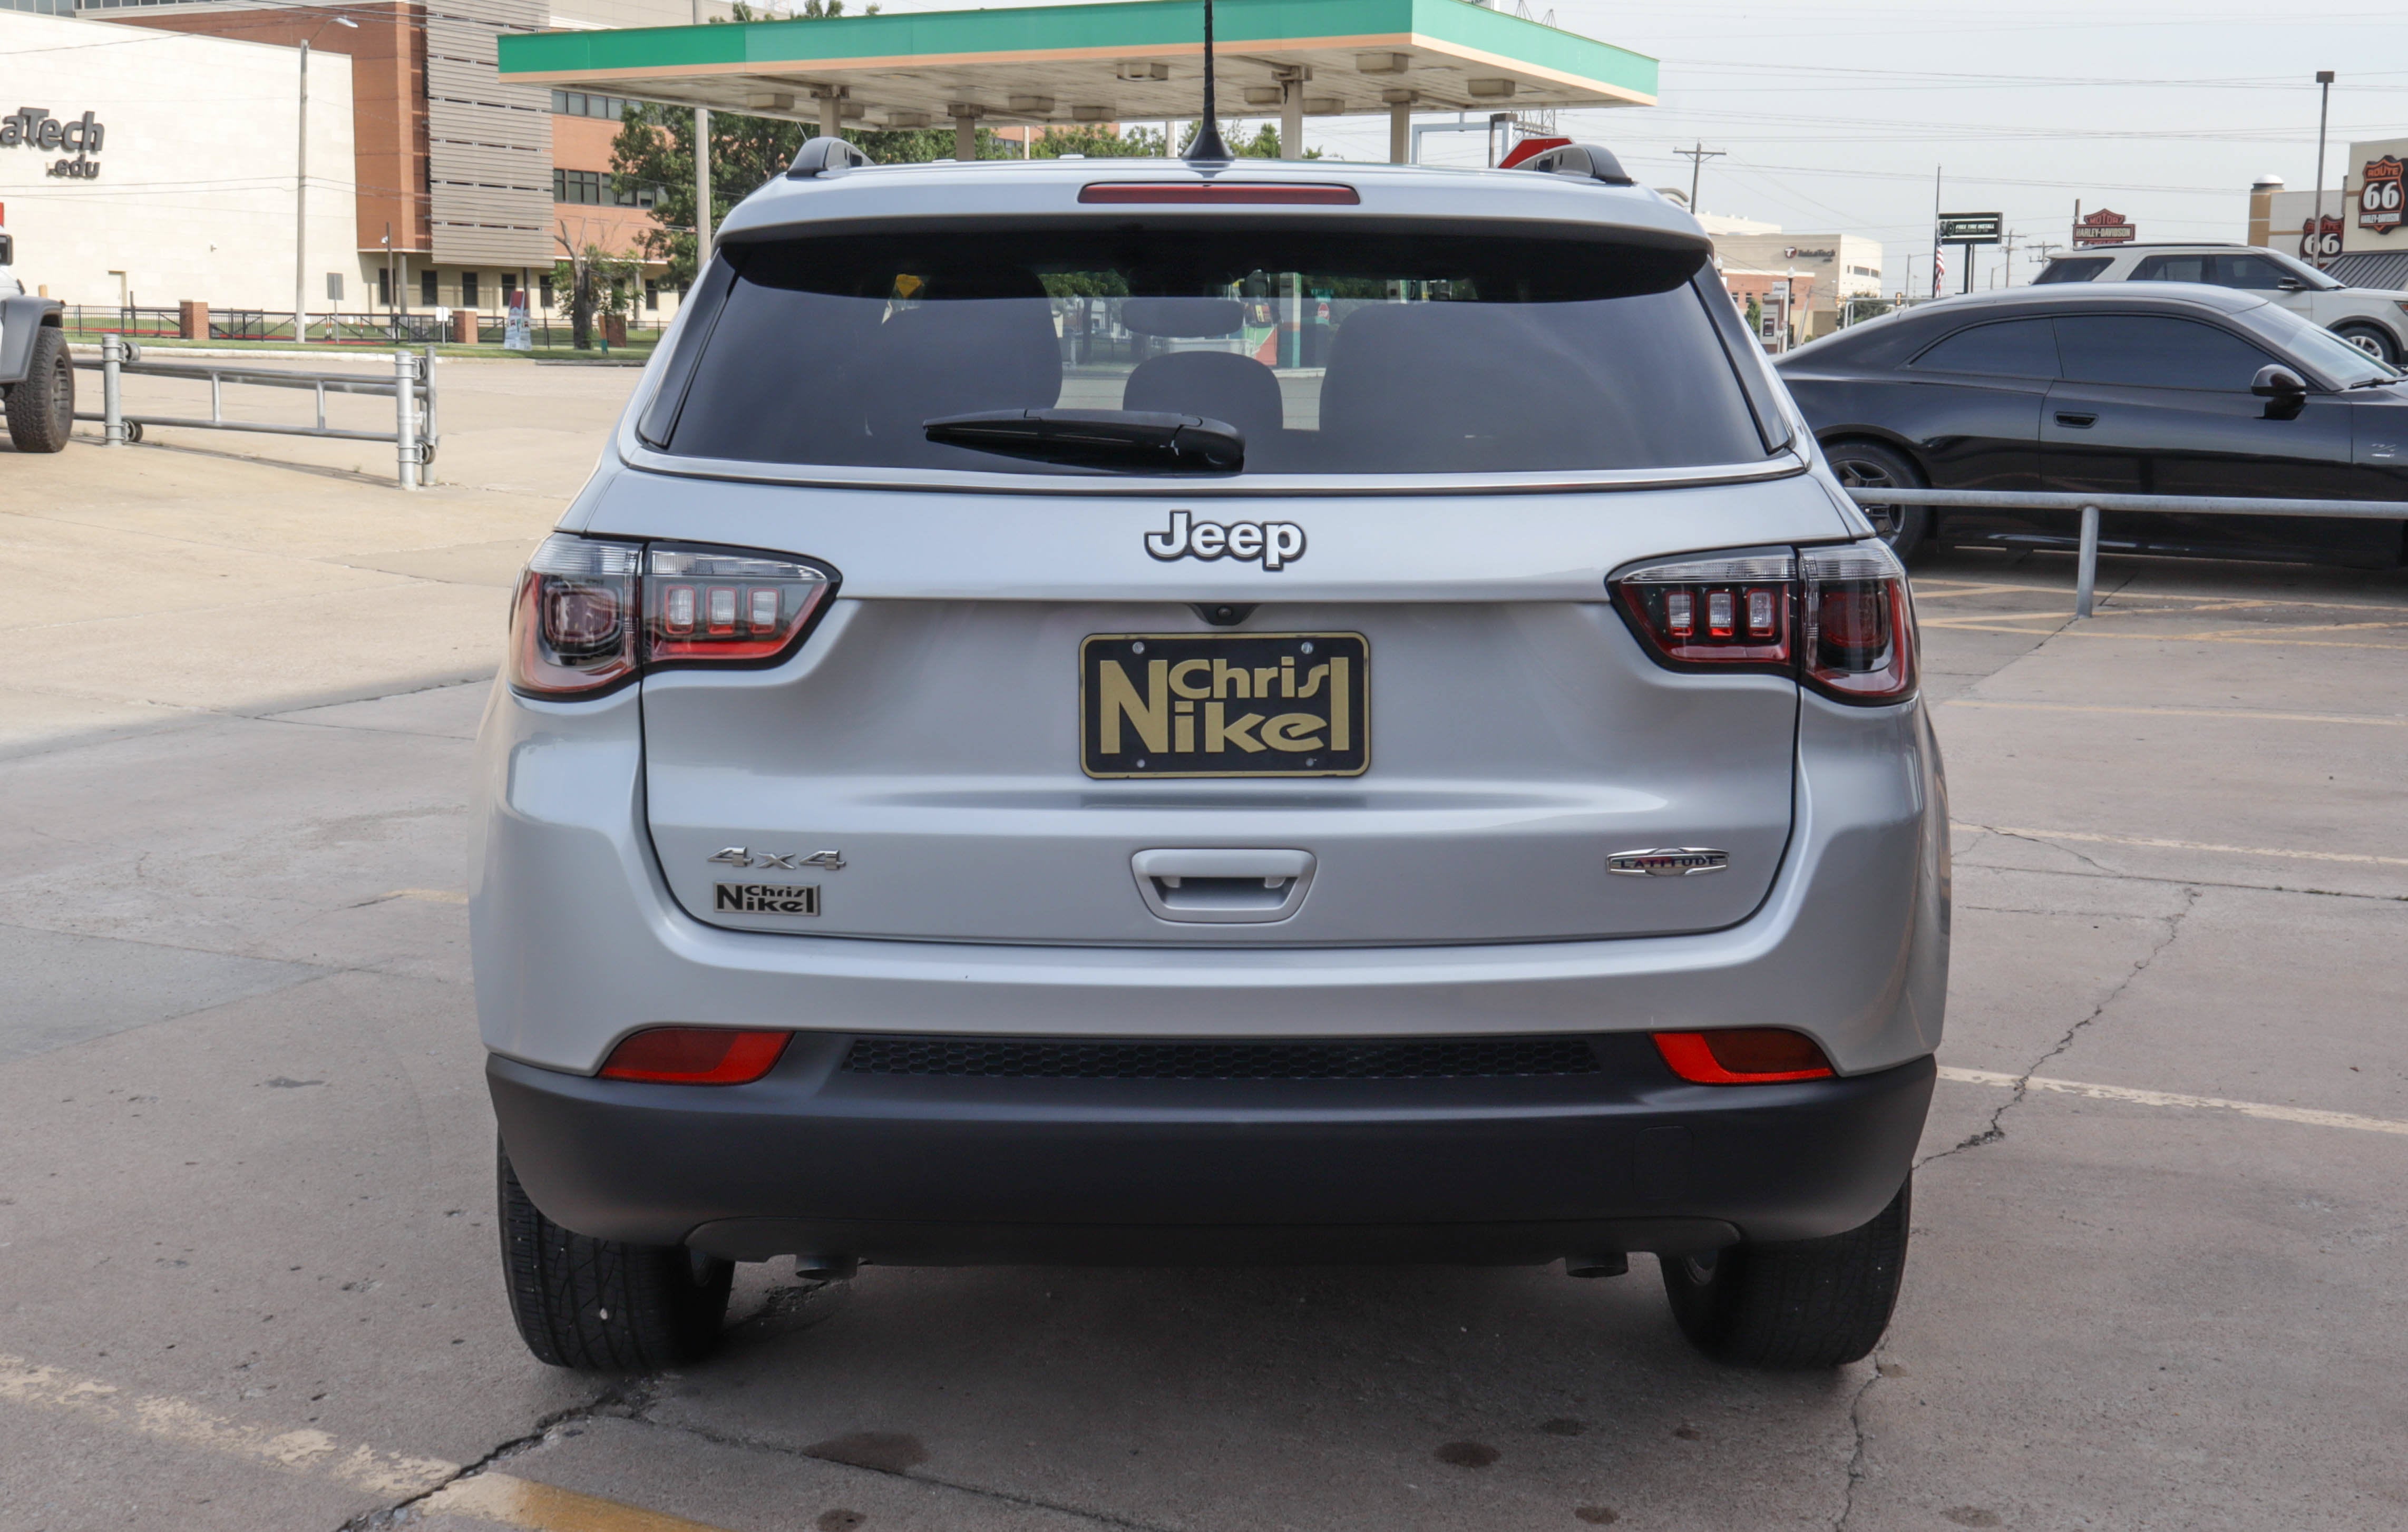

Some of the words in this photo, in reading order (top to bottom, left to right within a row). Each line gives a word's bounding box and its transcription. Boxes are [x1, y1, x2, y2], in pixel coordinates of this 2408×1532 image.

[47, 154, 100, 178] .edu
[2367, 167, 2398, 177] ROUTE
[2363, 182, 2400, 210] 66
[2089, 213, 2119, 224] MOTOR
[2076, 227, 2131, 237] HARLEY-DAVIDSON
[2304, 233, 2340, 255] 66
[1145, 510, 1306, 571] Jeep
[1168, 657, 1329, 699] Chris
[1100, 657, 1350, 754] Nikel
[708, 846, 846, 870] 4x4
[1620, 856, 1719, 869] LATITUDE
[717, 885, 814, 913] Nikel
[744, 885, 805, 897] Chris
